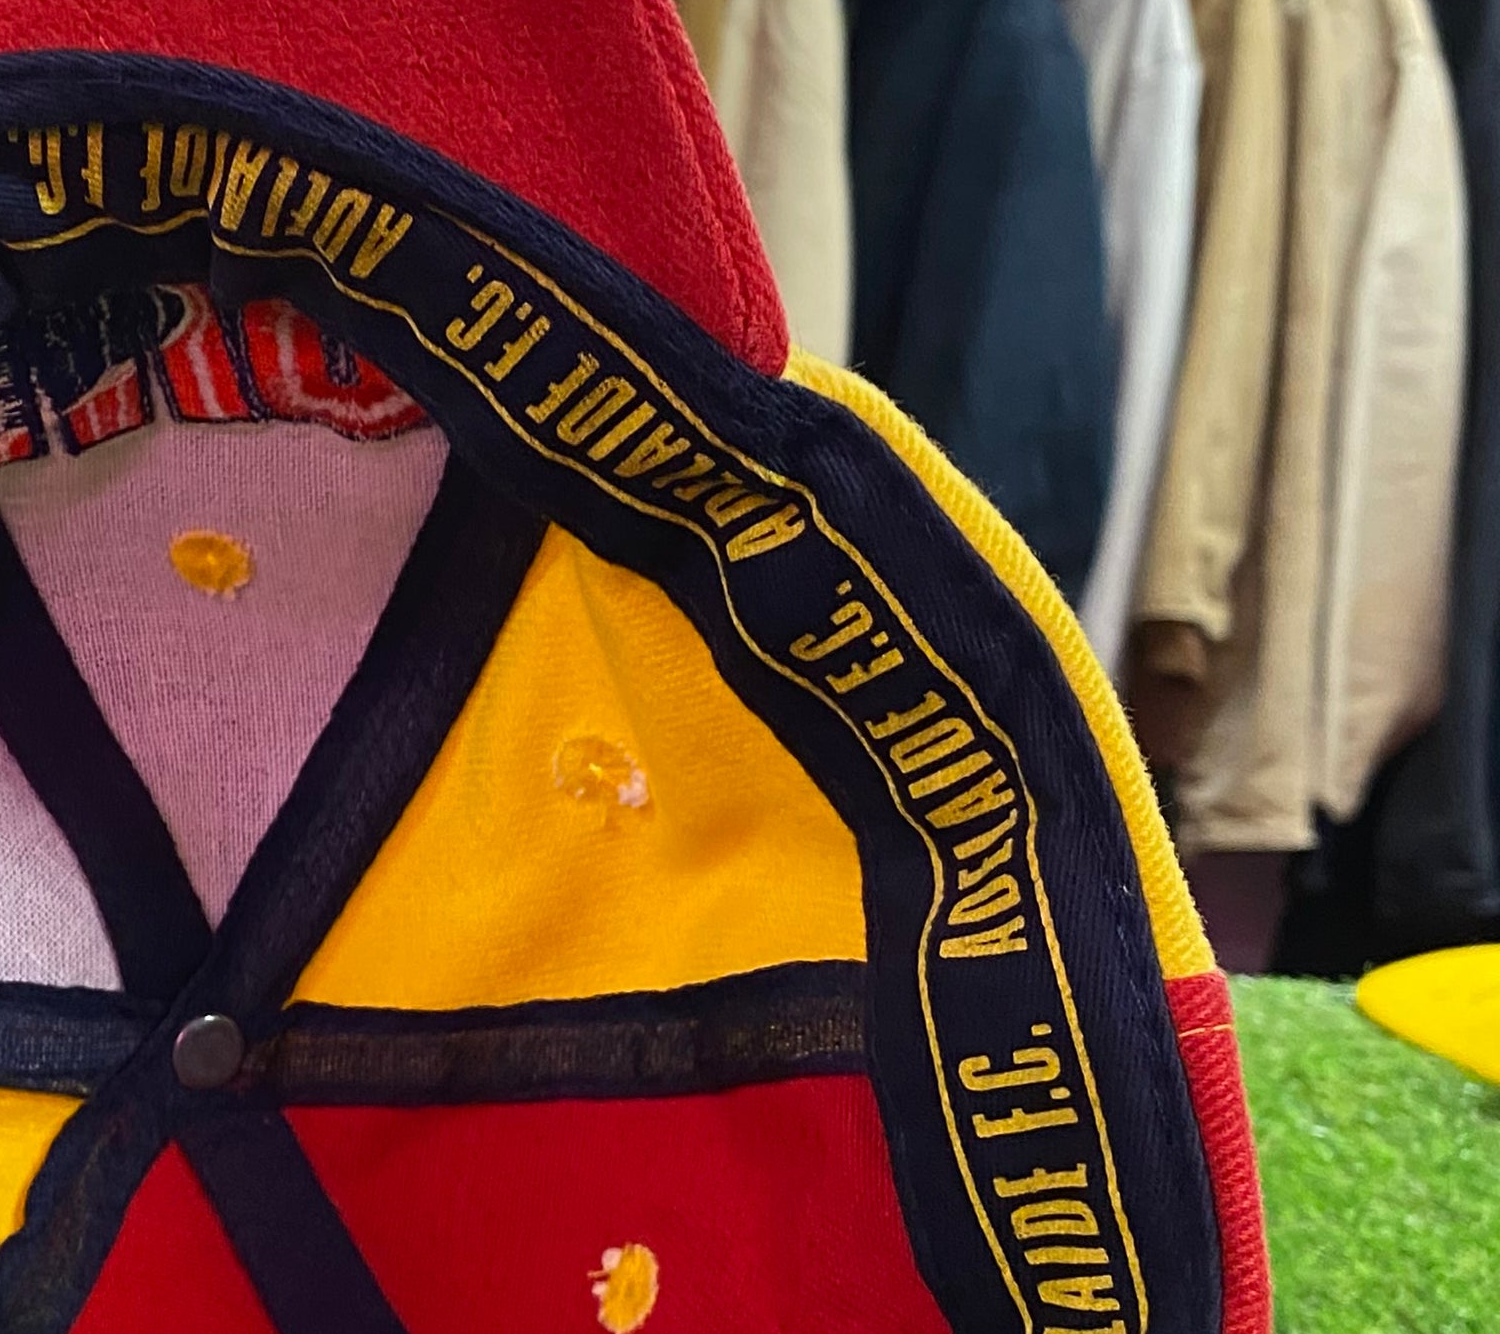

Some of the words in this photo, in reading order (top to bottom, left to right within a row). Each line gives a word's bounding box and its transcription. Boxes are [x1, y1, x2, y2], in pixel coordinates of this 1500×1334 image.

[445, 264, 552, 382] F.C.
[789, 579, 905, 695] F.C.
[865, 689, 1028, 959] ADELAIDE
[958, 1022, 1080, 1140] F.C.
